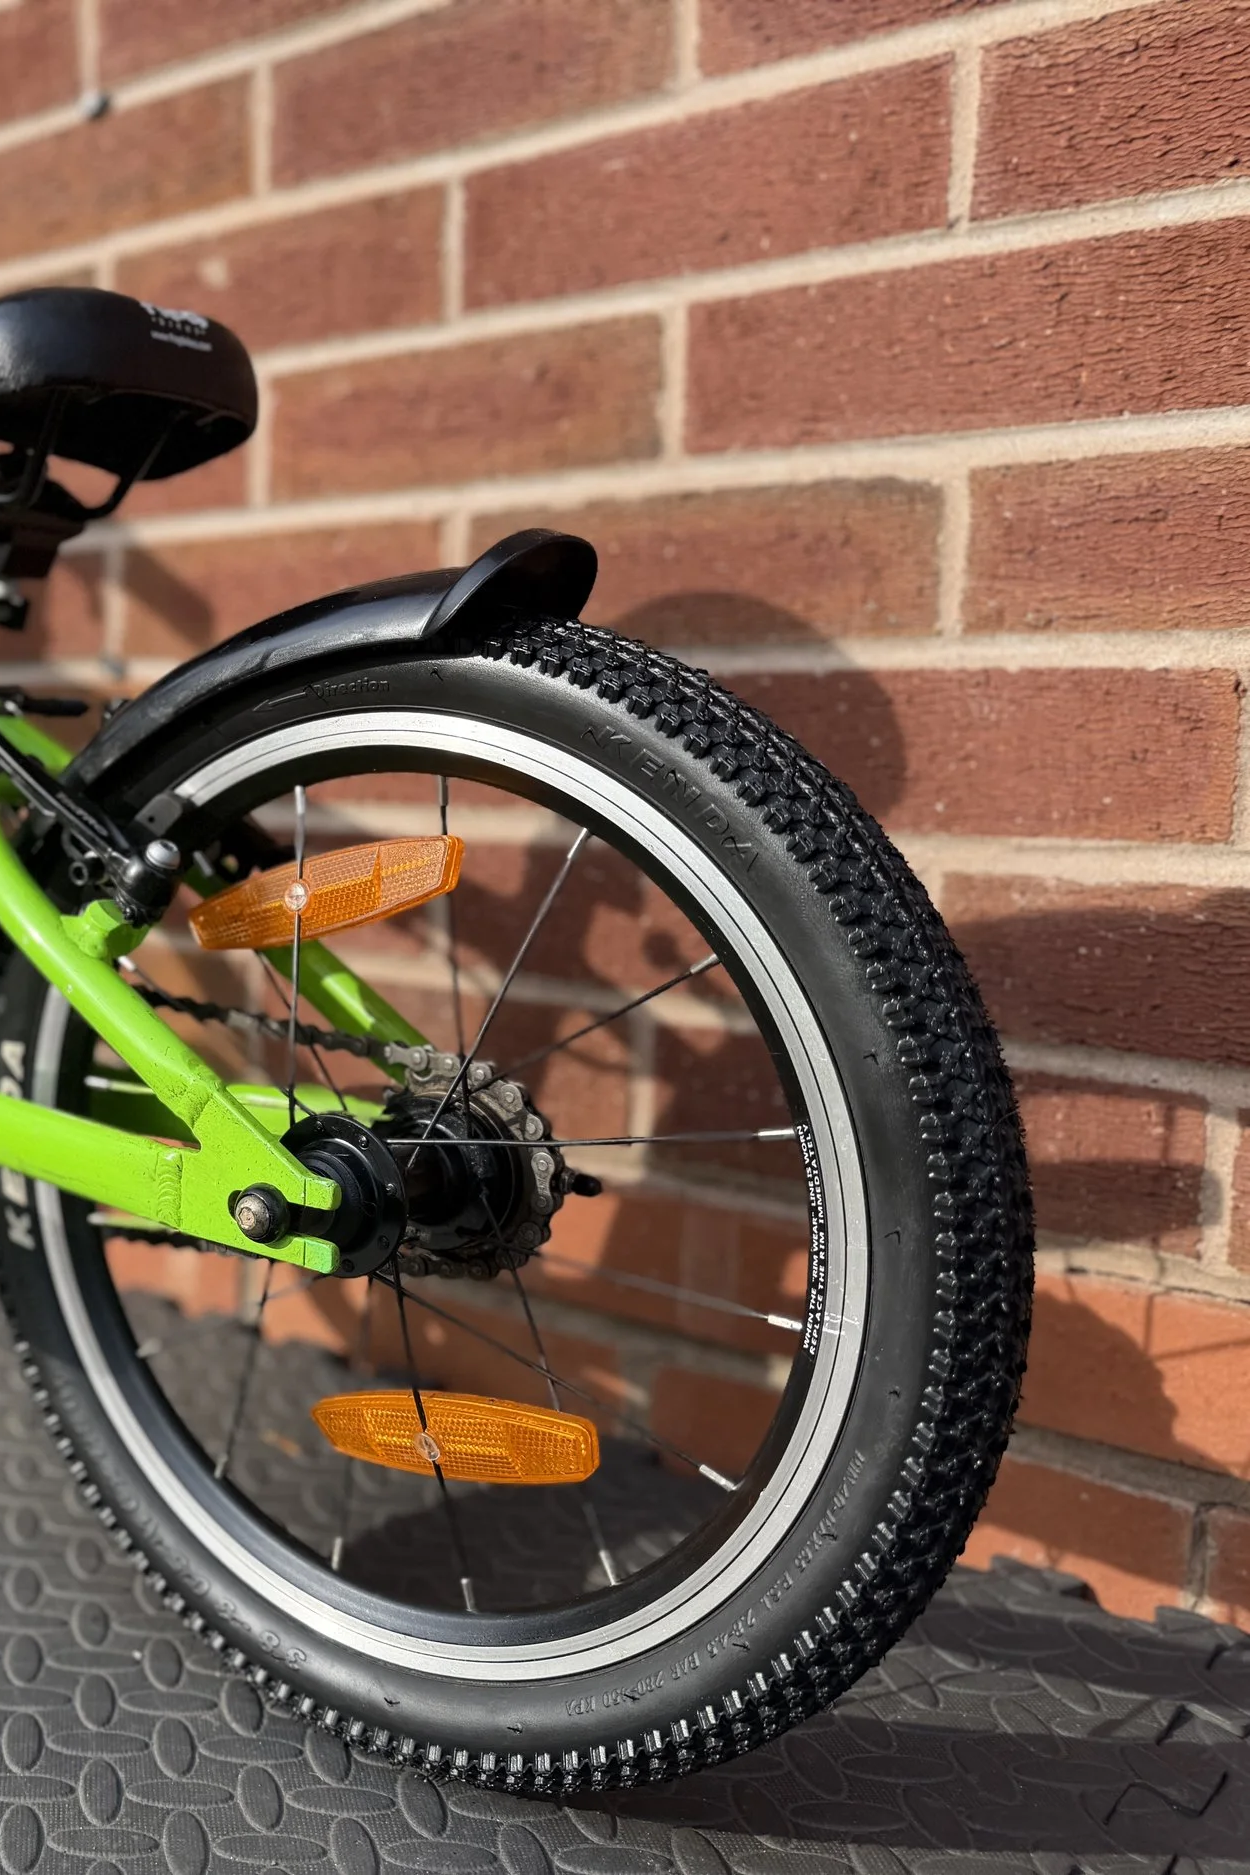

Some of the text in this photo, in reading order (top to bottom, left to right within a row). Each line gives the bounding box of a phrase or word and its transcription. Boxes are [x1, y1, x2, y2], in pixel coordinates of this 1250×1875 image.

[312, 676, 390, 698] Direction
[596, 725, 759, 873] KENDA
[796, 1125, 810, 1165] WORN
[802, 1123, 825, 1224] IMMEDIATELY
[805, 1166, 813, 1178] IS
[808, 1180, 817, 1207] LINE
[809, 1287, 817, 1310] THE
[802, 1313, 814, 1349] WHEN
[809, 1294, 825, 1356] REPLACE
[671, 1651, 700, 1680] BAR
[565, 1694, 596, 1716] KPA
